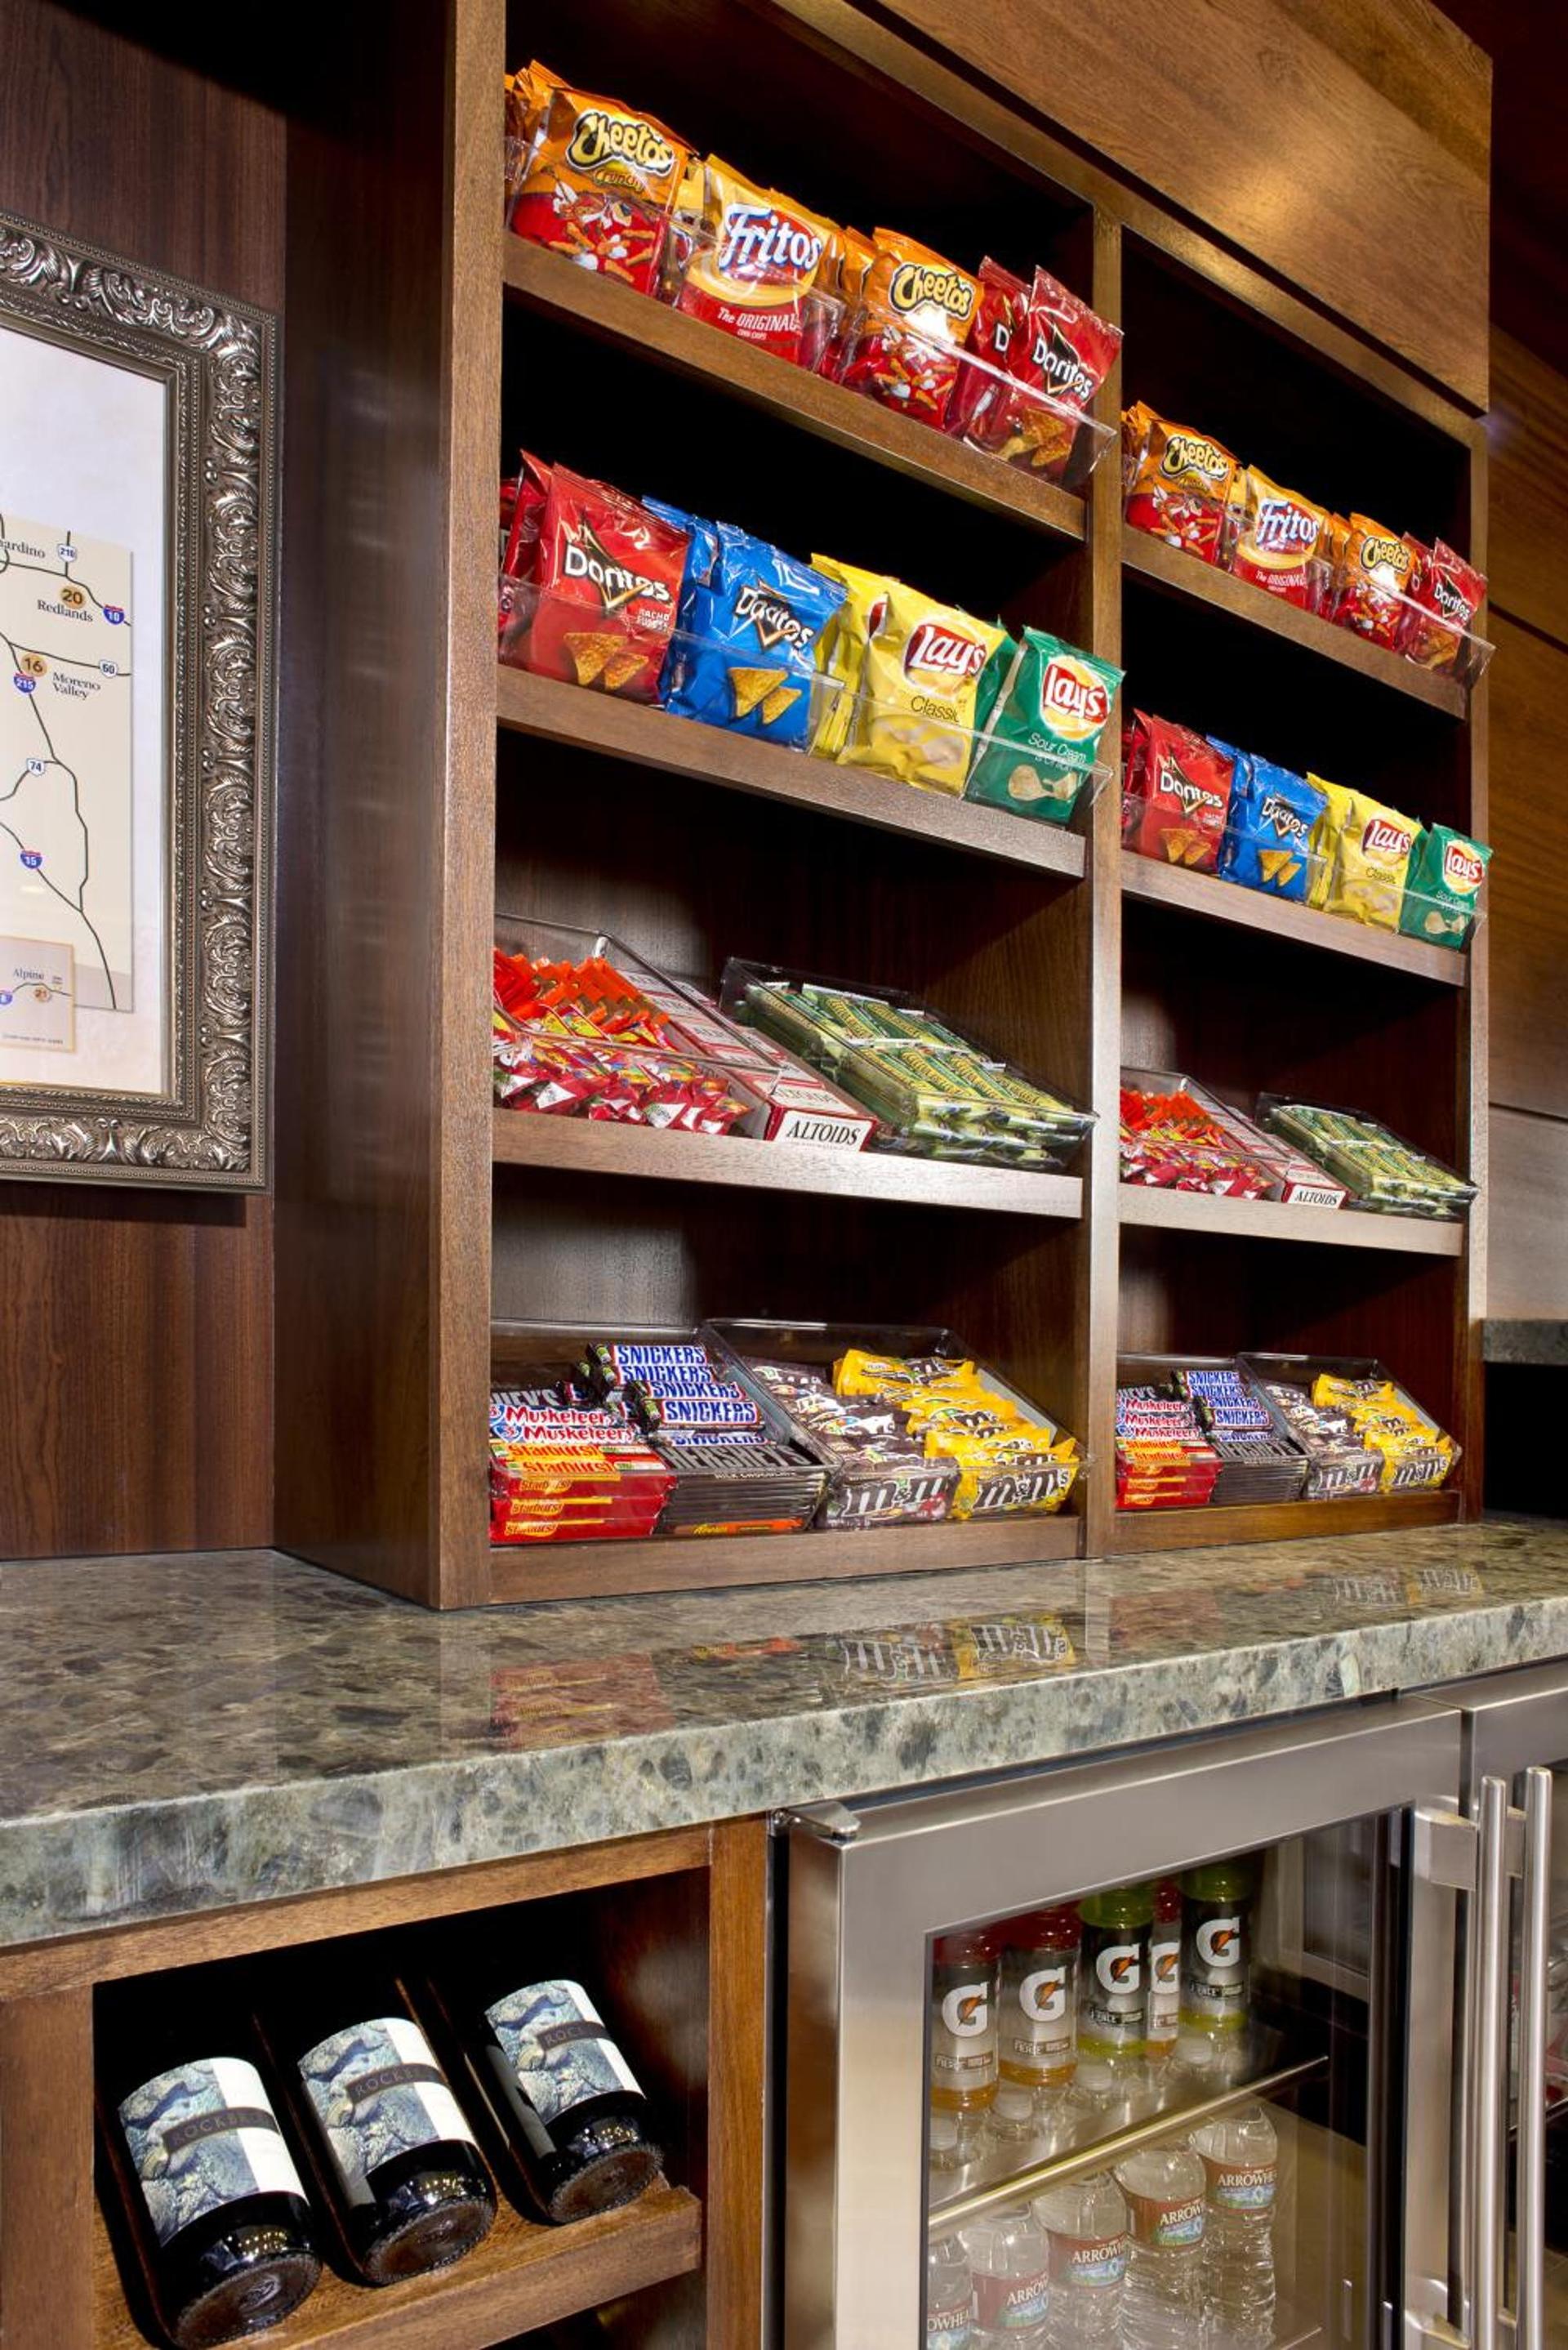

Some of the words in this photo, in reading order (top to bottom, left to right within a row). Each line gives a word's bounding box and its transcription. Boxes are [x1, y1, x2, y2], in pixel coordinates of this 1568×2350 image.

[568, 110, 673, 175] Cheetos
[719, 204, 823, 271] Fritos
[889, 264, 973, 319] Cheetos
[717, 306, 735, 324] The
[1032, 338, 1094, 399] Doritos
[1161, 436, 1229, 480] Cheetos
[1256, 499, 1320, 545] Fritos
[564, 544, 670, 601] Doritos
[62, 588, 83, 605] 20
[1434, 583, 1470, 621] Doritos
[37, 600, 93, 622] Redlands
[734, 586, 815, 649] Doritos
[24, 658, 43, 673] 16
[52, 672, 101, 691] Moreno
[52, 683, 89, 700] Valley
[1028, 732, 1058, 752] Sour
[29, 760, 42, 772] 74
[1160, 771, 1223, 808] Doritos
[786, 1121, 861, 1144] ALTOIDS
[1295, 1190, 1339, 1206] ALTOIDS
[618, 1346, 706, 1365] SNICKERS
[624, 1366, 712, 1383] SNICKERS
[1188, 1371, 1240, 1385] SNICKERS
[653, 1381, 741, 1398] SNICKERS
[506, 1405, 616, 1425] Musketeers
[666, 1401, 756, 1422] SNICKERS
[1216, 1409, 1268, 1425] SNICKERS
[523, 1426, 635, 1441] Musketeers
[508, 1444, 599, 1456] Starburst
[660, 1444, 813, 1469] HERSHEY'S
[523, 1460, 616, 1473] Starburst
[1196, 1917, 1241, 1968] G
[1096, 1943, 1140, 1994] G
[1020, 1965, 1067, 2022] G
[942, 1982, 989, 2037] G
